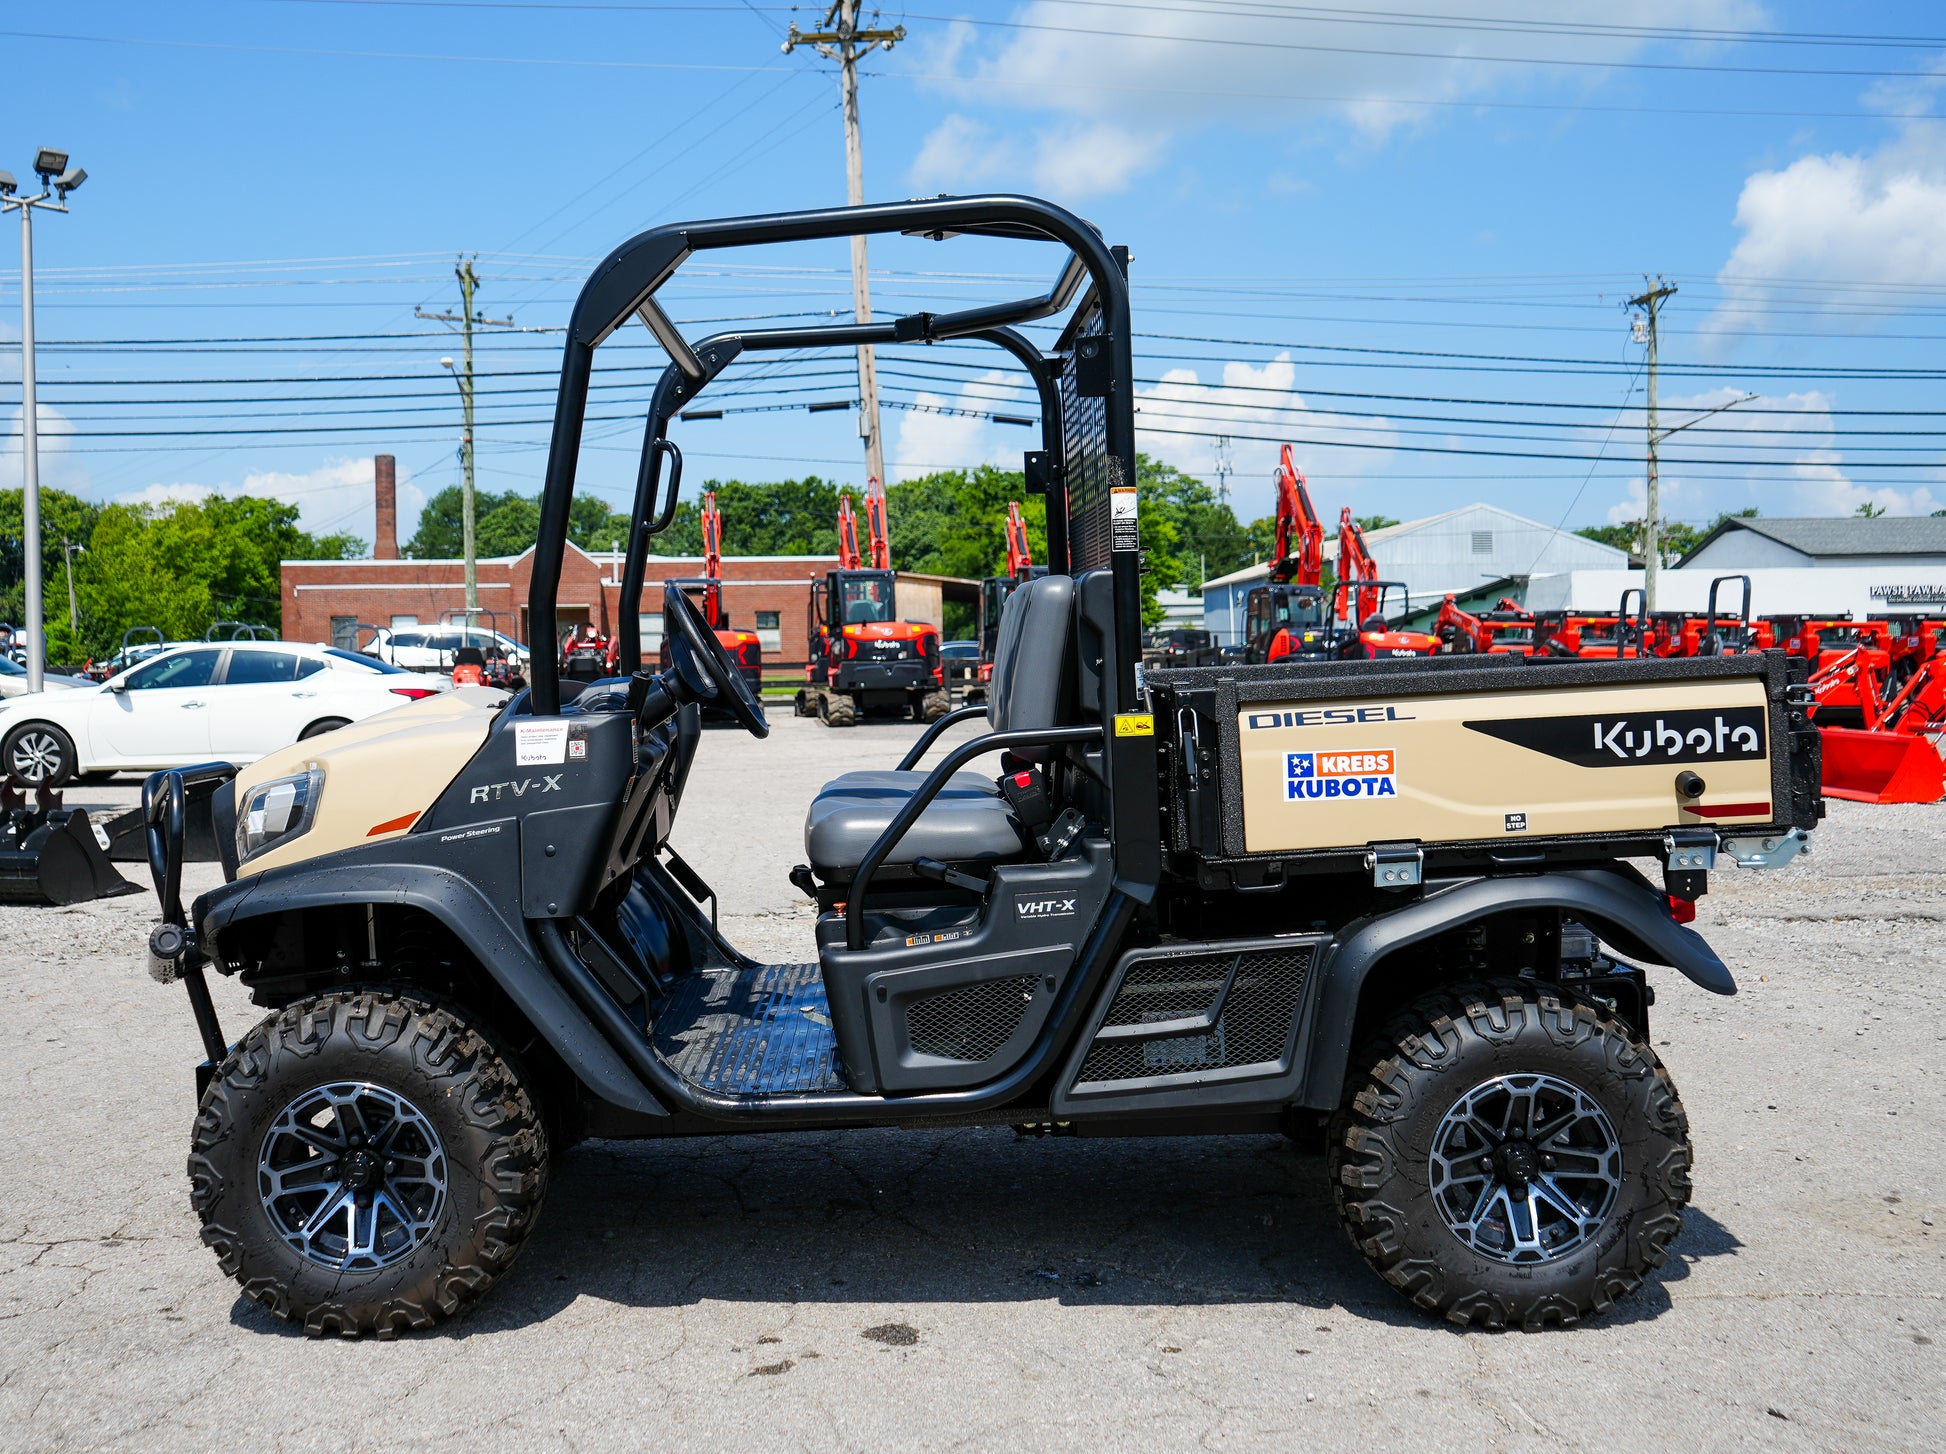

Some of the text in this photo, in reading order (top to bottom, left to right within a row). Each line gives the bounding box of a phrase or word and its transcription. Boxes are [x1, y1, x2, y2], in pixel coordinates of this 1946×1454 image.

[1870, 585, 1905, 596] PAWSH
[874, 640, 901, 649] Kubota
[1391, 649, 1417, 657] Kubota
[1248, 706, 1417, 730] DIESEL
[1593, 716, 1759, 759] Kubota
[1321, 754, 1390, 774] KREBS
[469, 773, 564, 804] RTV-X
[1288, 777, 1396, 799] KUBOTA
[440, 826, 501, 842] Power Steering
[1017, 898, 1077, 914] VHT-X
